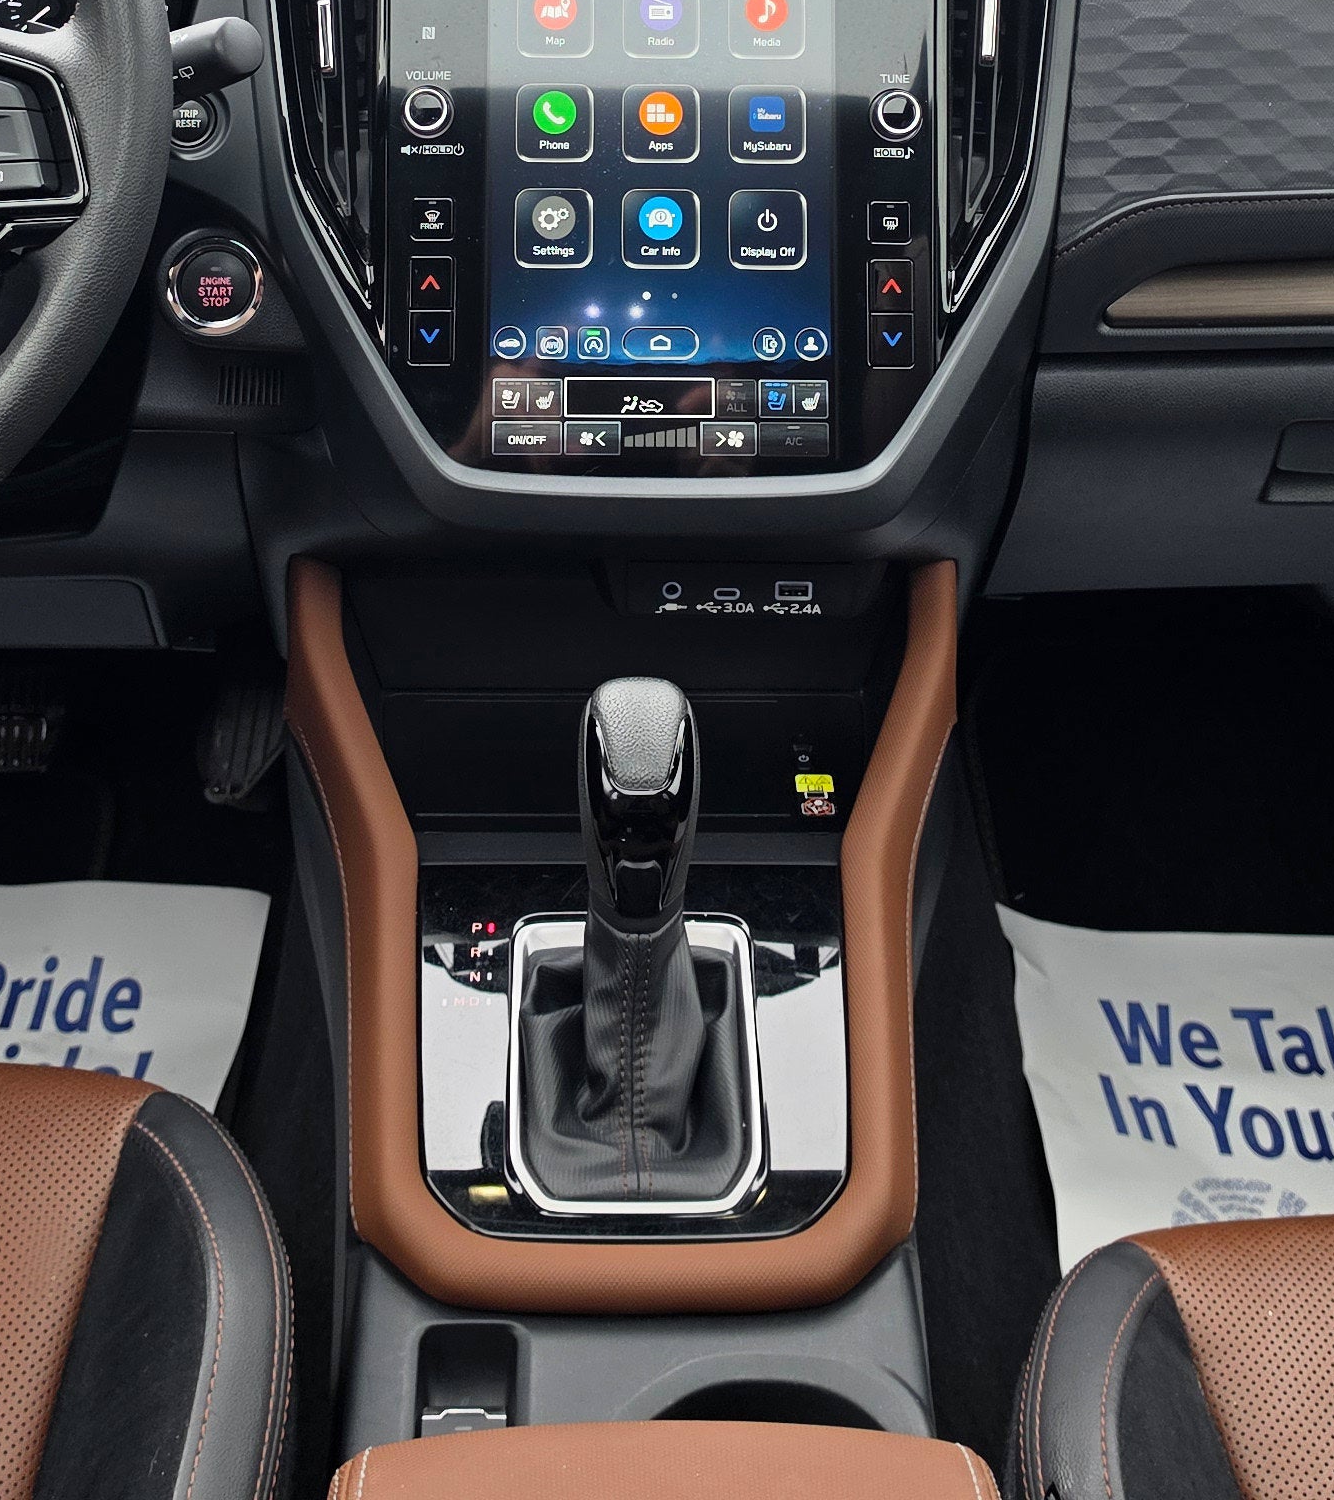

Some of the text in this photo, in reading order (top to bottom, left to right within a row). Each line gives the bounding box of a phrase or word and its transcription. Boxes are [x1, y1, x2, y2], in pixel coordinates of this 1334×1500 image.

[545, 37, 566, 47] Map
[647, 37, 675, 46] Radio
[753, 37, 781, 46] Media
[405, 70, 452, 81] VOLUME
[880, 73, 910, 84] TUNE
[179, 109, 199, 118] TRIP
[175, 120, 201, 128] RESET
[423, 146, 453, 154] HOLD
[539, 140, 570, 150] Phone
[648, 140, 674, 152] Apps
[743, 141, 792, 152] MySubaru
[874, 148, 904, 157] HOLD
[420, 222, 444, 230] FRONT
[532, 245, 575, 257] Settings
[640, 246, 681, 256] Car Info
[740, 246, 795, 258] Display Off
[200, 276, 232, 286] ENGINE
[198, 286, 233, 297] START
[202, 297, 230, 307] STOP
[726, 403, 747, 412] ALL
[507, 435, 547, 445] ON/OFF
[785, 437, 803, 446] A/C
[723, 602, 754, 613] 3.0A
[789, 604, 821, 614] 2.4A
[471, 922, 482, 933] P
[470, 947, 481, 958] R
[469, 971, 481, 982] N
[1099, 998, 1222, 1070] We
[1099, 1075, 1178, 1147] In
